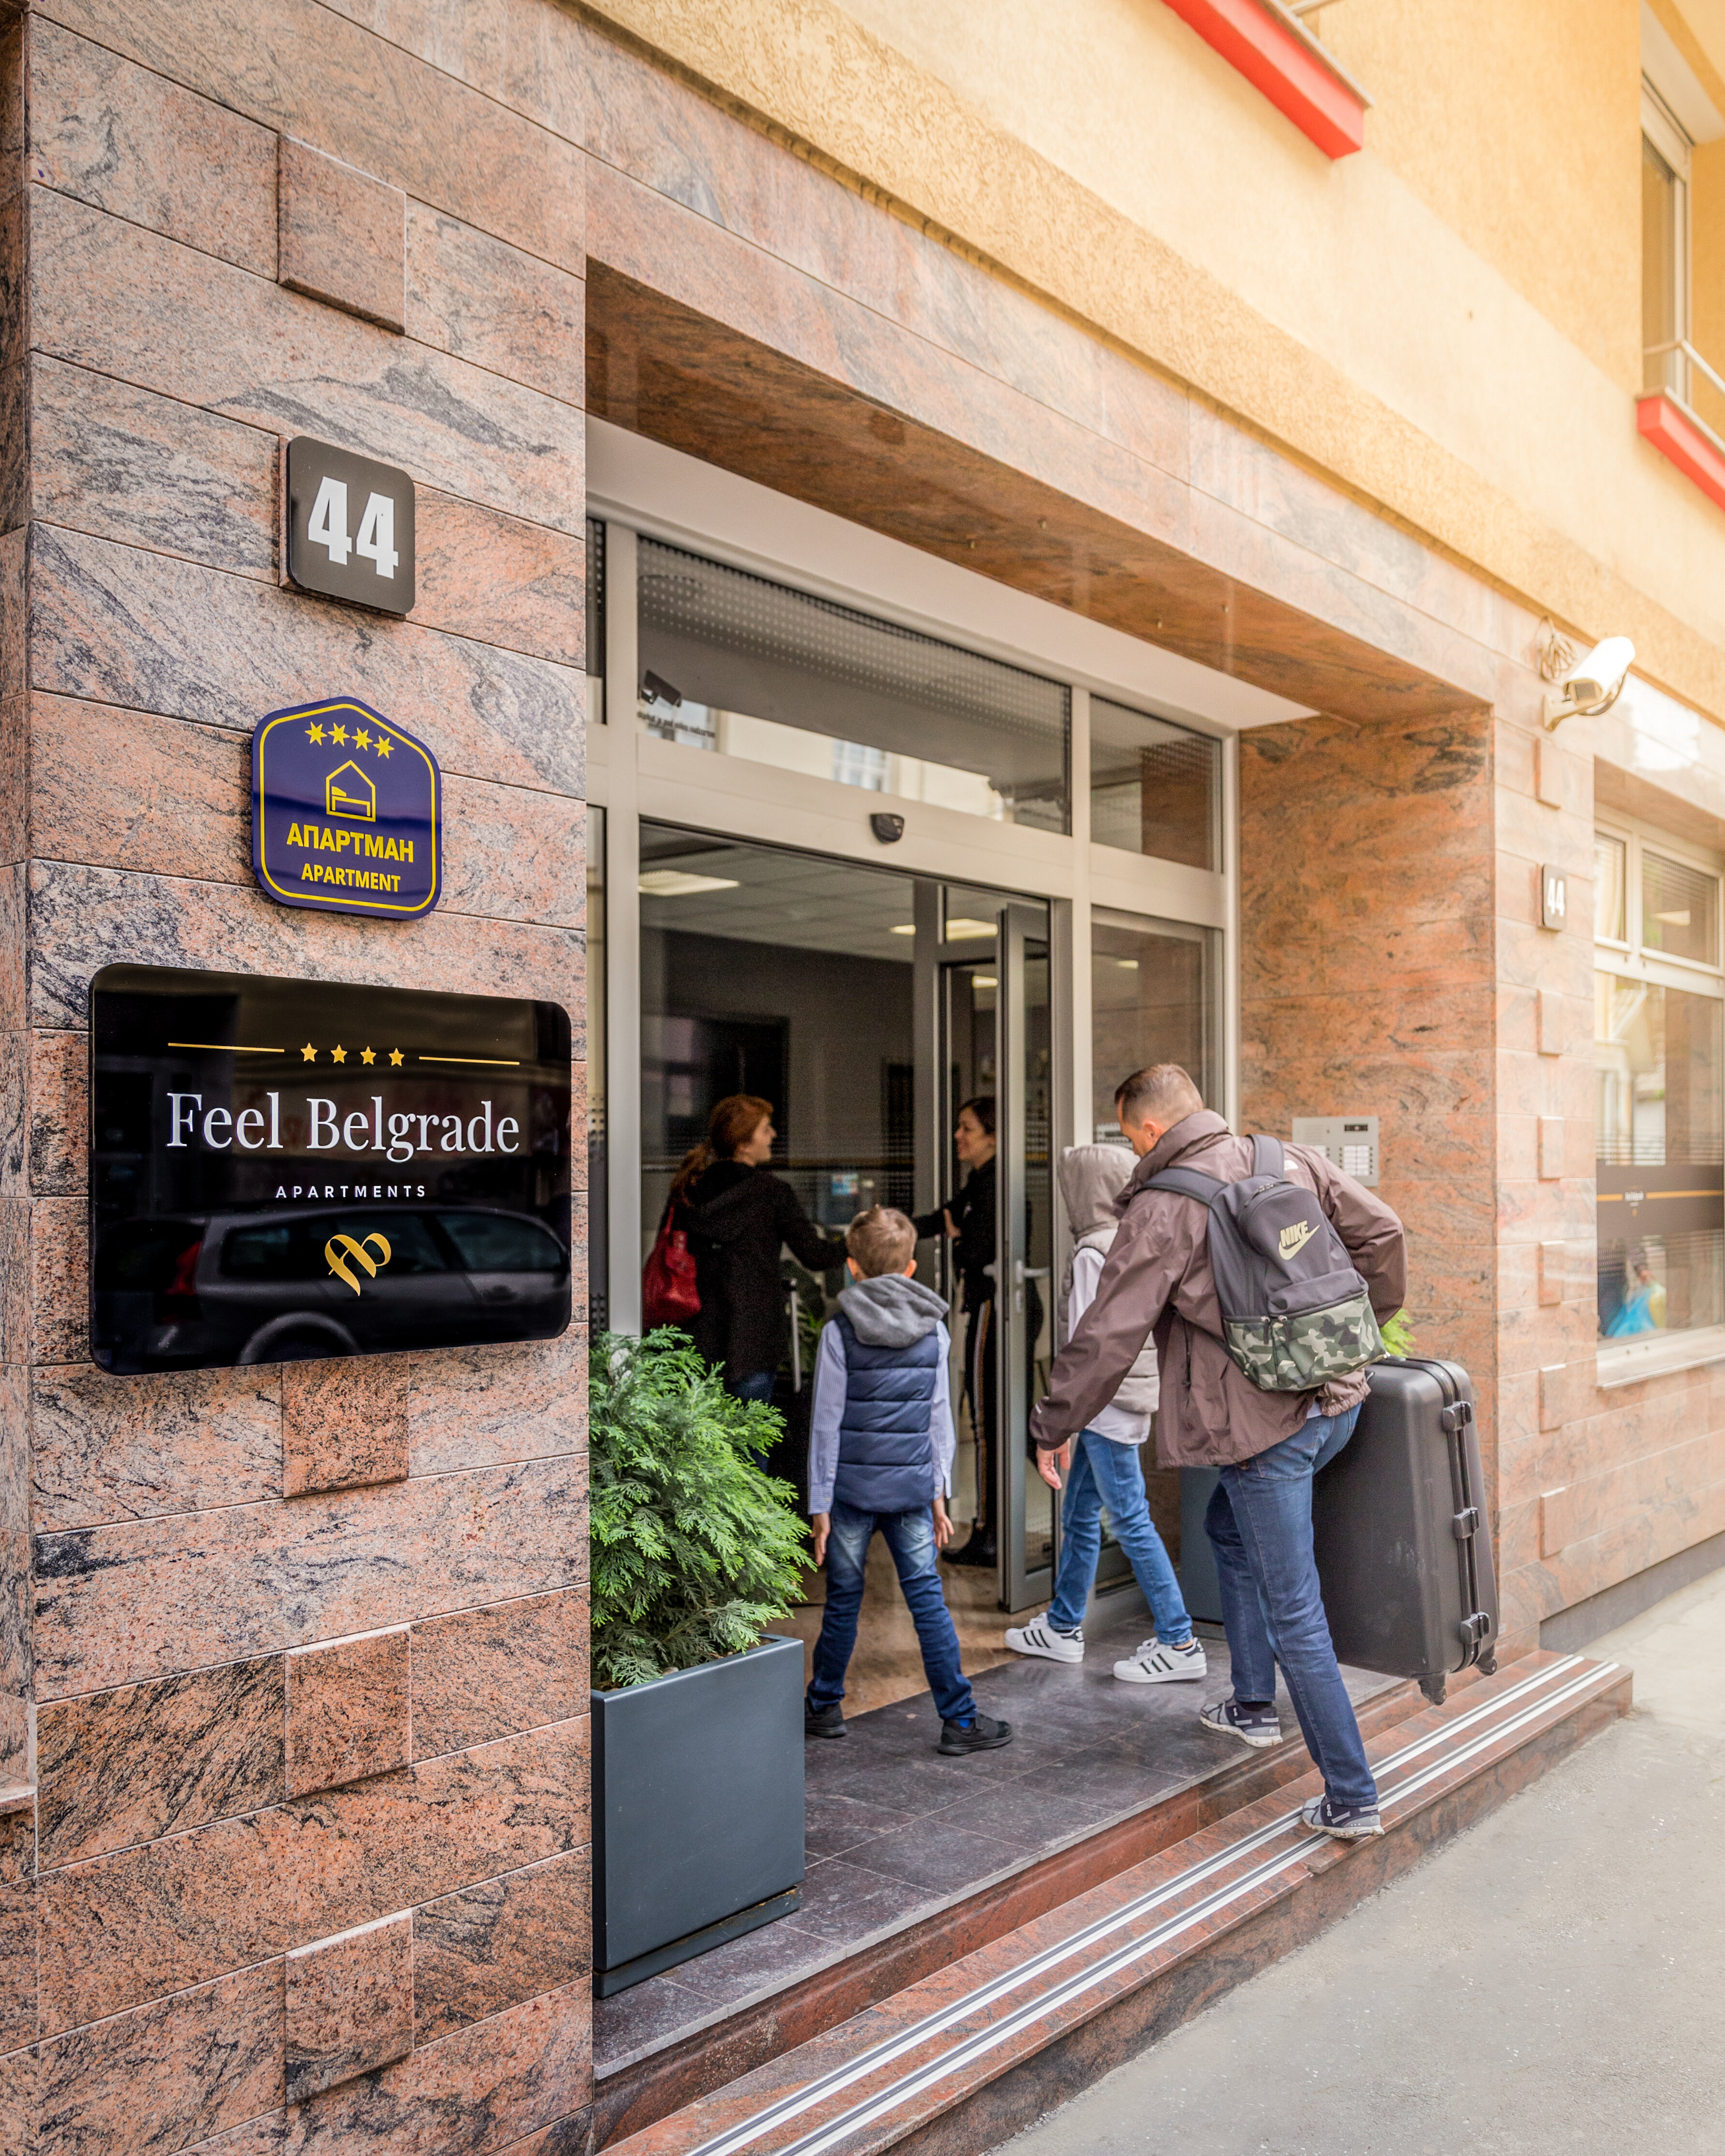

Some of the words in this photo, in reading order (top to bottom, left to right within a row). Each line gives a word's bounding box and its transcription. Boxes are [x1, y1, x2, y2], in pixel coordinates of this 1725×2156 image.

[308, 476, 399, 579] 44
[286, 822, 414, 863] АПАРТМАН
[301, 862, 401, 893] APARTMENT
[1547, 878, 1565, 916] 44
[167, 1091, 284, 1149] Feel
[306, 1095, 520, 1163] Belgrade
[275, 1185, 425, 1199] APARTMENTS
[1280, 1220, 1308, 1247] NIKE
